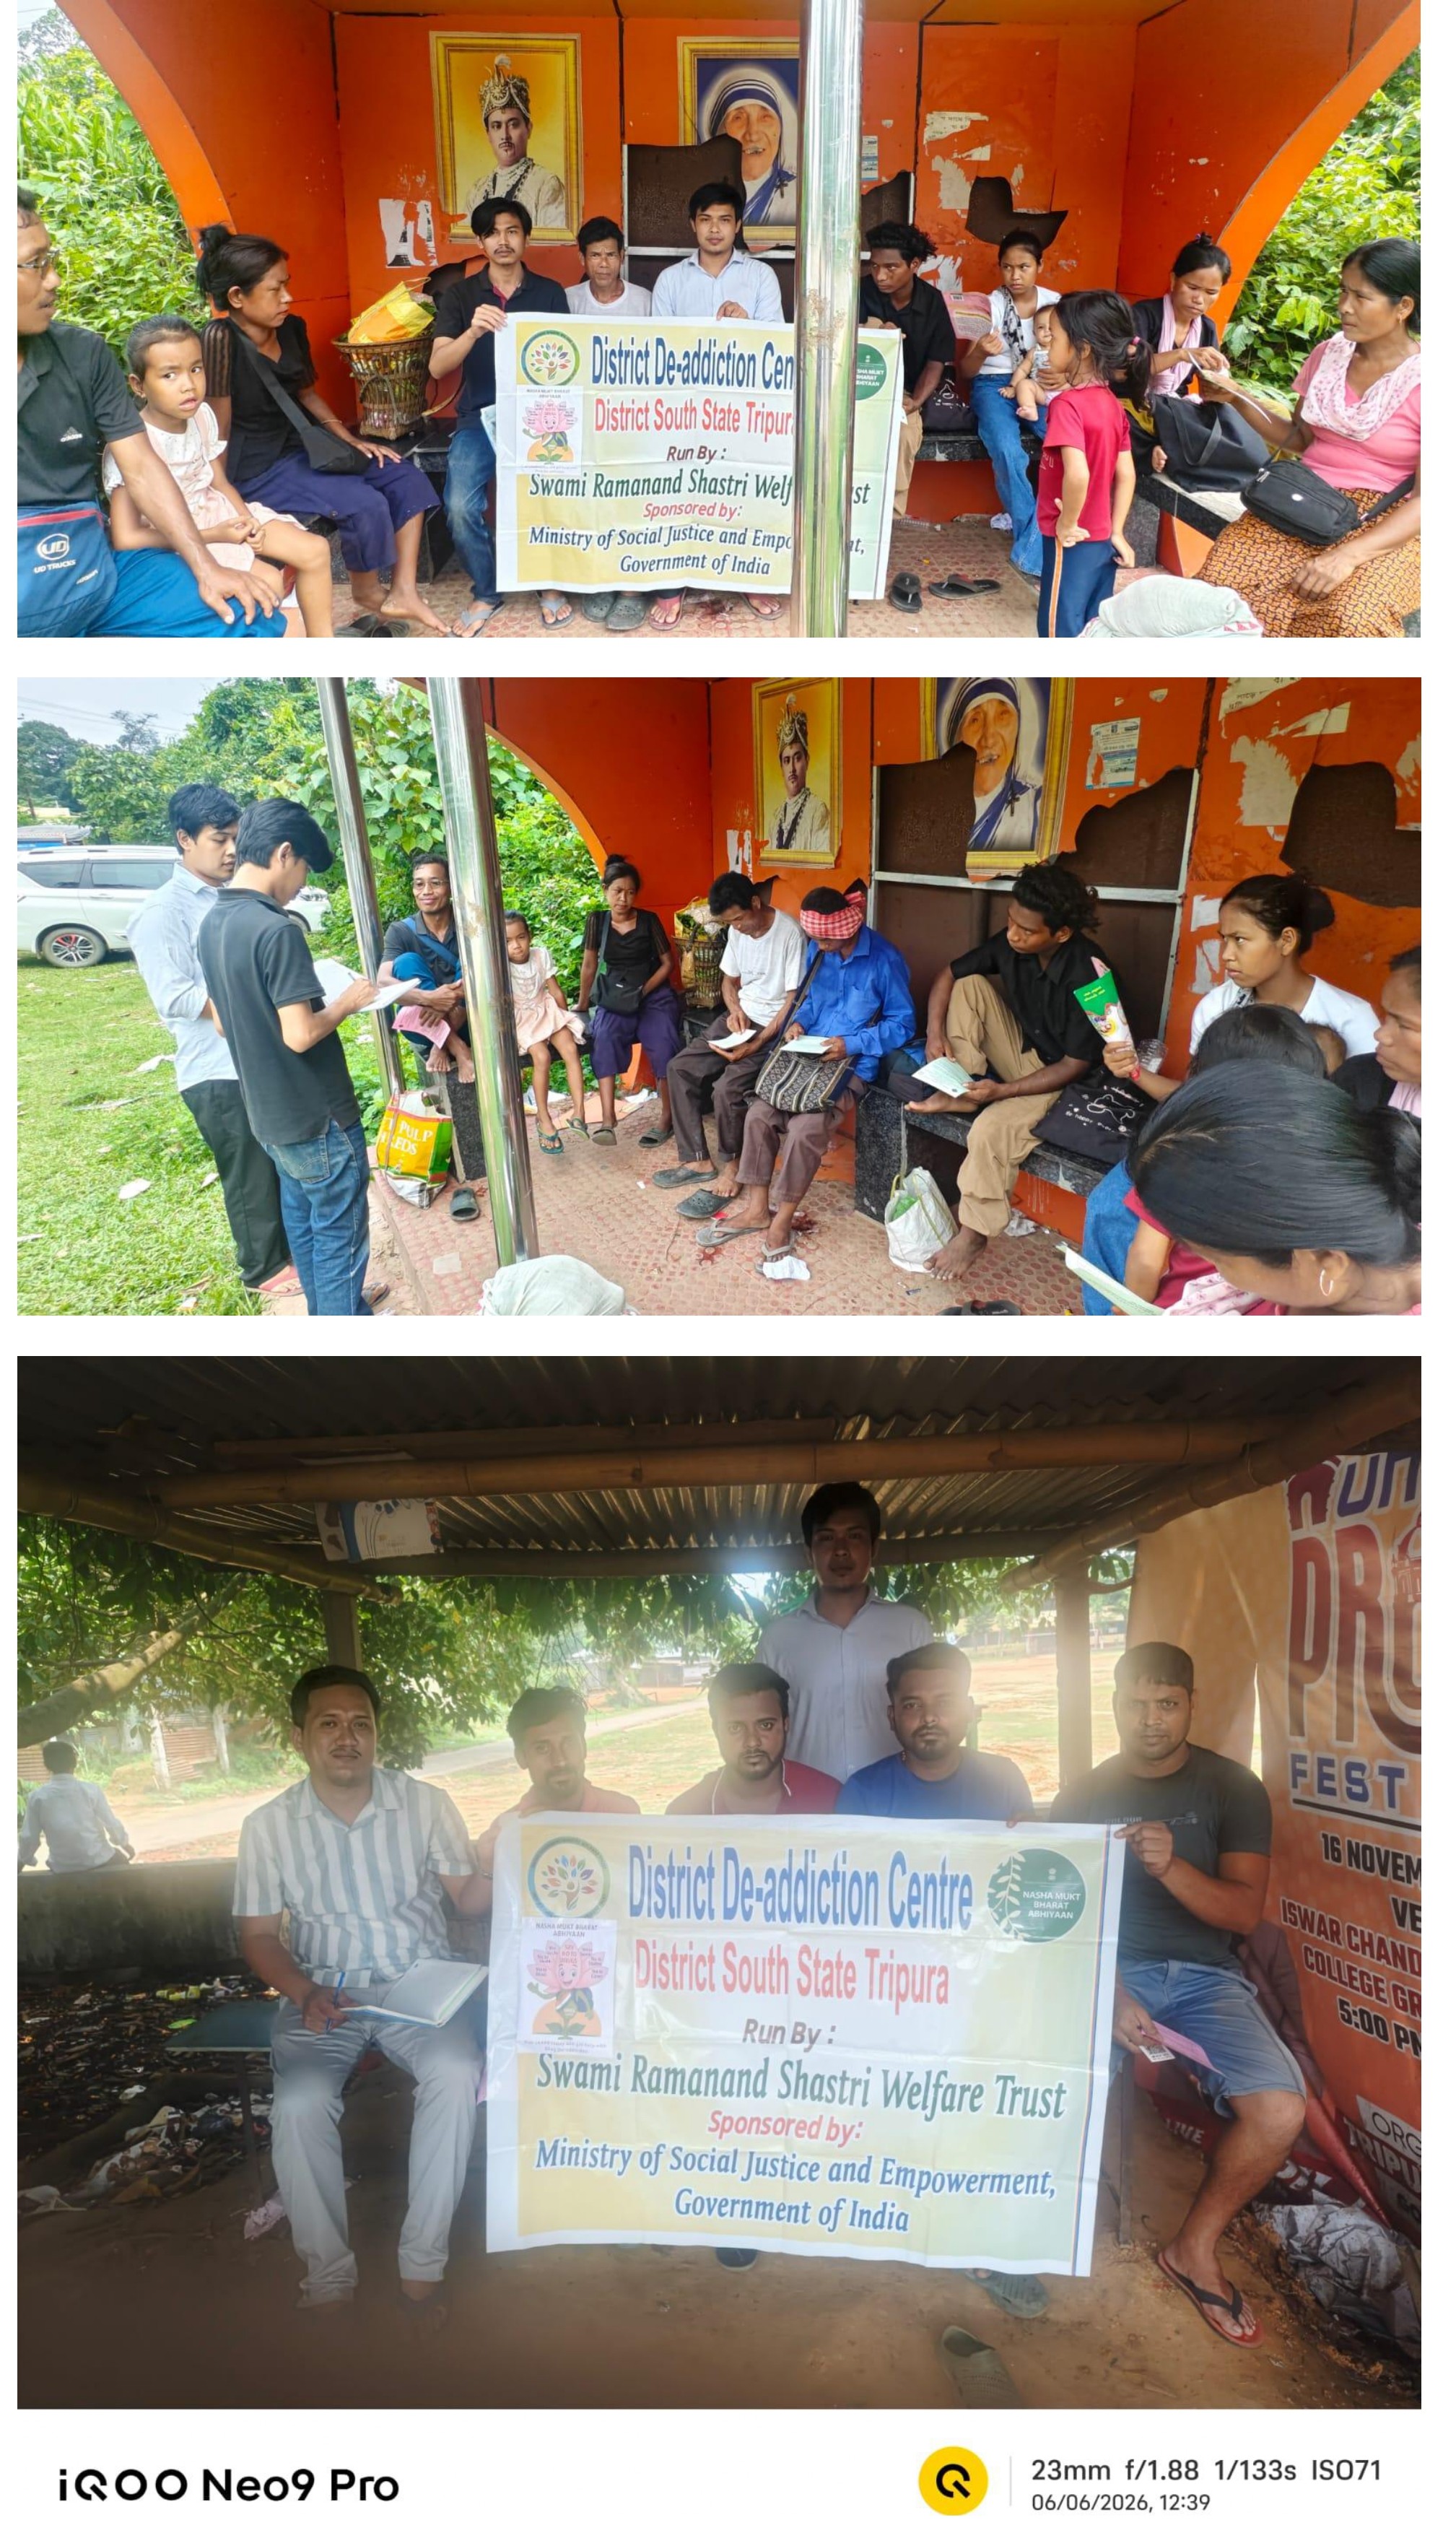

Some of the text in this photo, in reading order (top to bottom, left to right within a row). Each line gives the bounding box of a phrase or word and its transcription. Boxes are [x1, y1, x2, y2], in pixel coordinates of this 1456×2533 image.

[592, 336, 650, 386] District
[655, 337, 757, 388] De-addiction
[595, 398, 650, 431] District
[654, 398, 697, 431] South
[702, 397, 741, 433] State
[746, 401, 794, 442] Tripur
[666, 446, 693, 461] Run
[697, 445, 718, 464] By
[529, 472, 587, 498] Swami
[593, 469, 684, 498] Ramanand
[688, 469, 749, 498] Shastri
[643, 503, 743, 521] Sponsored by:
[529, 526, 593, 551] Ministry
[597, 529, 615, 550] of
[617, 526, 663, 546] Social
[663, 523, 714, 547] Justice
[719, 528, 748, 545] and
[47, 559, 77, 570] TRUCKS
[621, 554, 770, 575] Government of India
[398, 1121, 433, 1142] PULP
[1291, 1753, 1405, 1809] FEST
[1322, 1833, 1342, 1864] 16
[629, 1845, 715, 1921] District
[723, 1847, 879, 1926] De-addiction
[888, 1851, 972, 1931] Centre
[1034, 1900, 1069, 1910] BHARAT
[1028, 1910, 1073, 1919] ABHIYAAN
[1282, 1899, 1342, 1946] ISWAR
[635, 1939, 949, 2016] District South State Tripura
[1303, 1945, 1387, 2004] COLLEGE
[742, 2018, 785, 2044] Run
[790, 2021, 821, 2053] By
[1338, 1998, 1389, 2043] 5:00
[537, 2053, 1067, 2121] Swami Ramanand Shastri Welfare Trust
[708, 2110, 863, 2148] Sponsored by:
[536, 2138, 1055, 2199] Ministry of Social Justice and Empowerment,
[675, 2188, 910, 2233] Government of India
